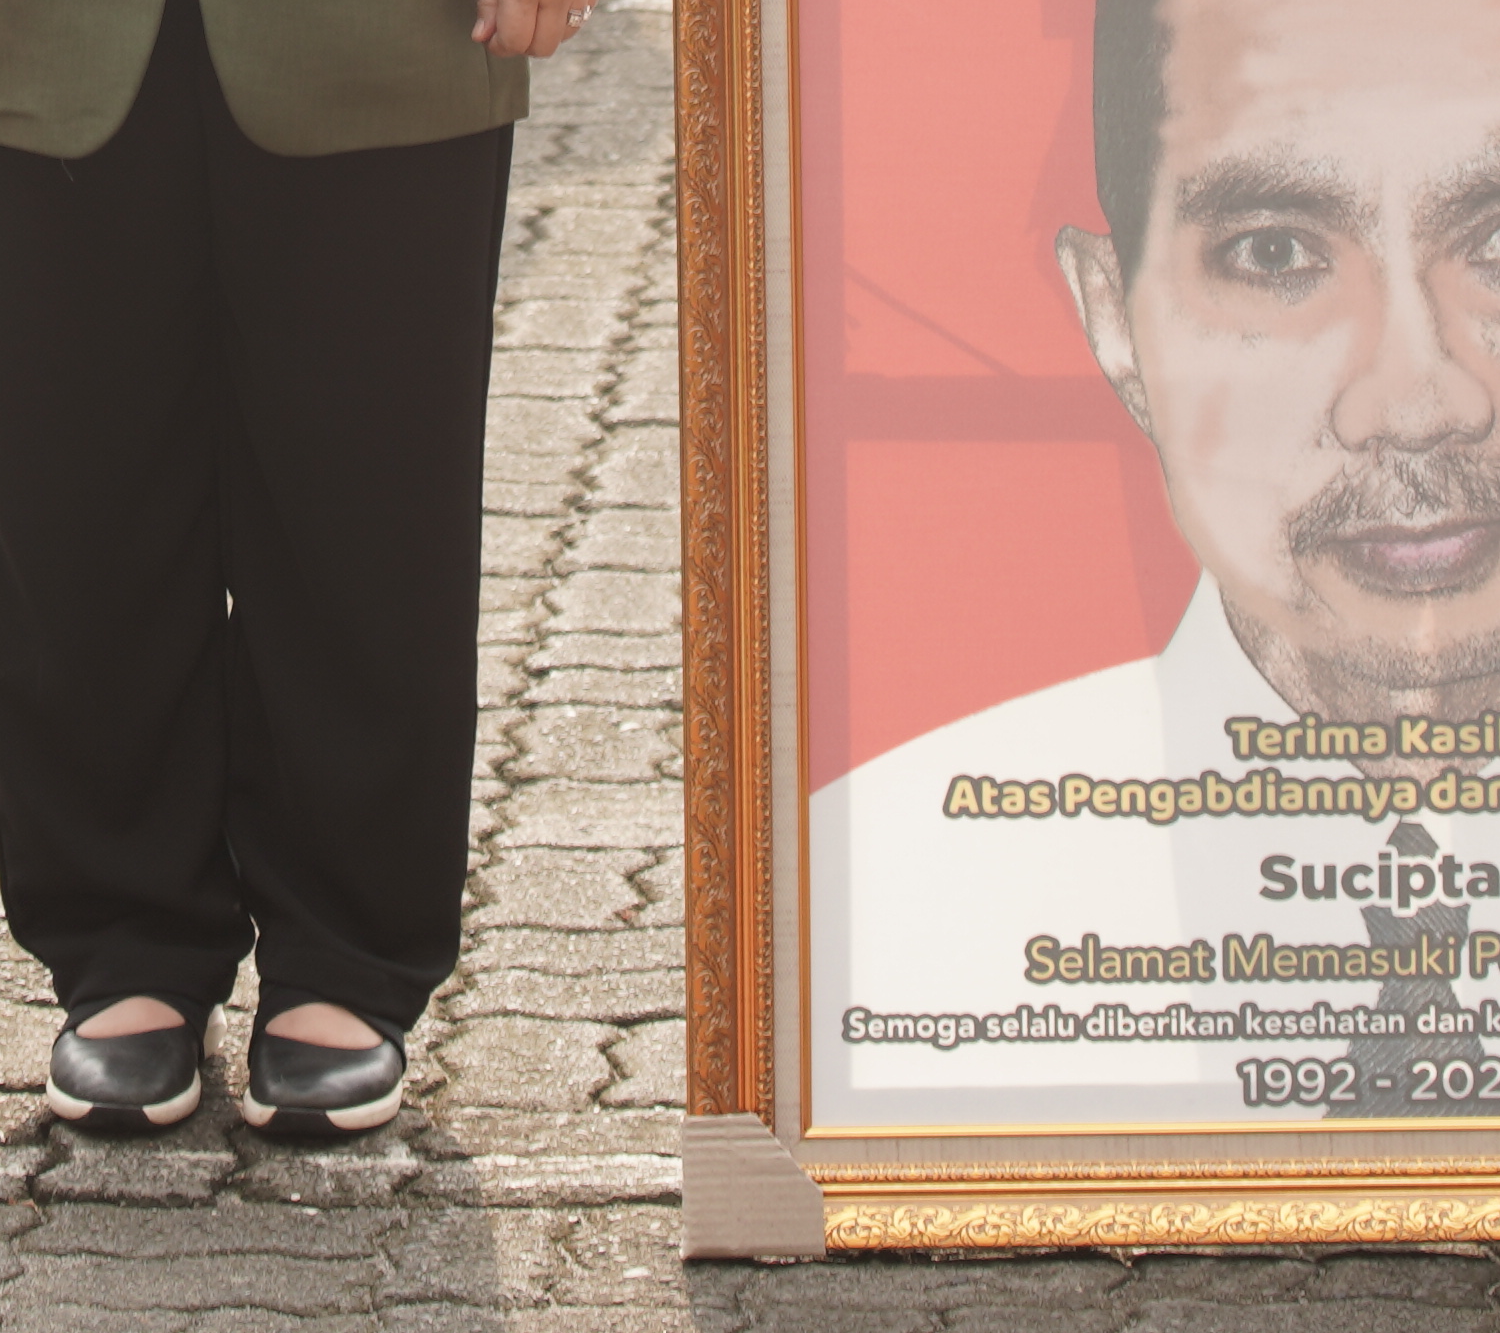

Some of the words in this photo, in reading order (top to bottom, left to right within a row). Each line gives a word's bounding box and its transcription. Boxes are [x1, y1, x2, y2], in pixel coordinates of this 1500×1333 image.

[1229, 719, 1388, 756] Terima
[948, 779, 1054, 816] Atas
[1063, 772, 1419, 821] Pengabdiannya
[1259, 852, 1500, 909] Sucipta
[1026, 936, 1213, 981] Selamat
[1227, 935, 1457, 979] Memasuki
[848, 1010, 976, 1047] Semoga
[986, 1007, 1076, 1040] selalu
[1085, 1006, 1235, 1038] diberikan
[1244, 1004, 1406, 1036] kesehatan
[1416, 1003, 1475, 1035] dan
[1241, 1060, 1356, 1103] 1992
